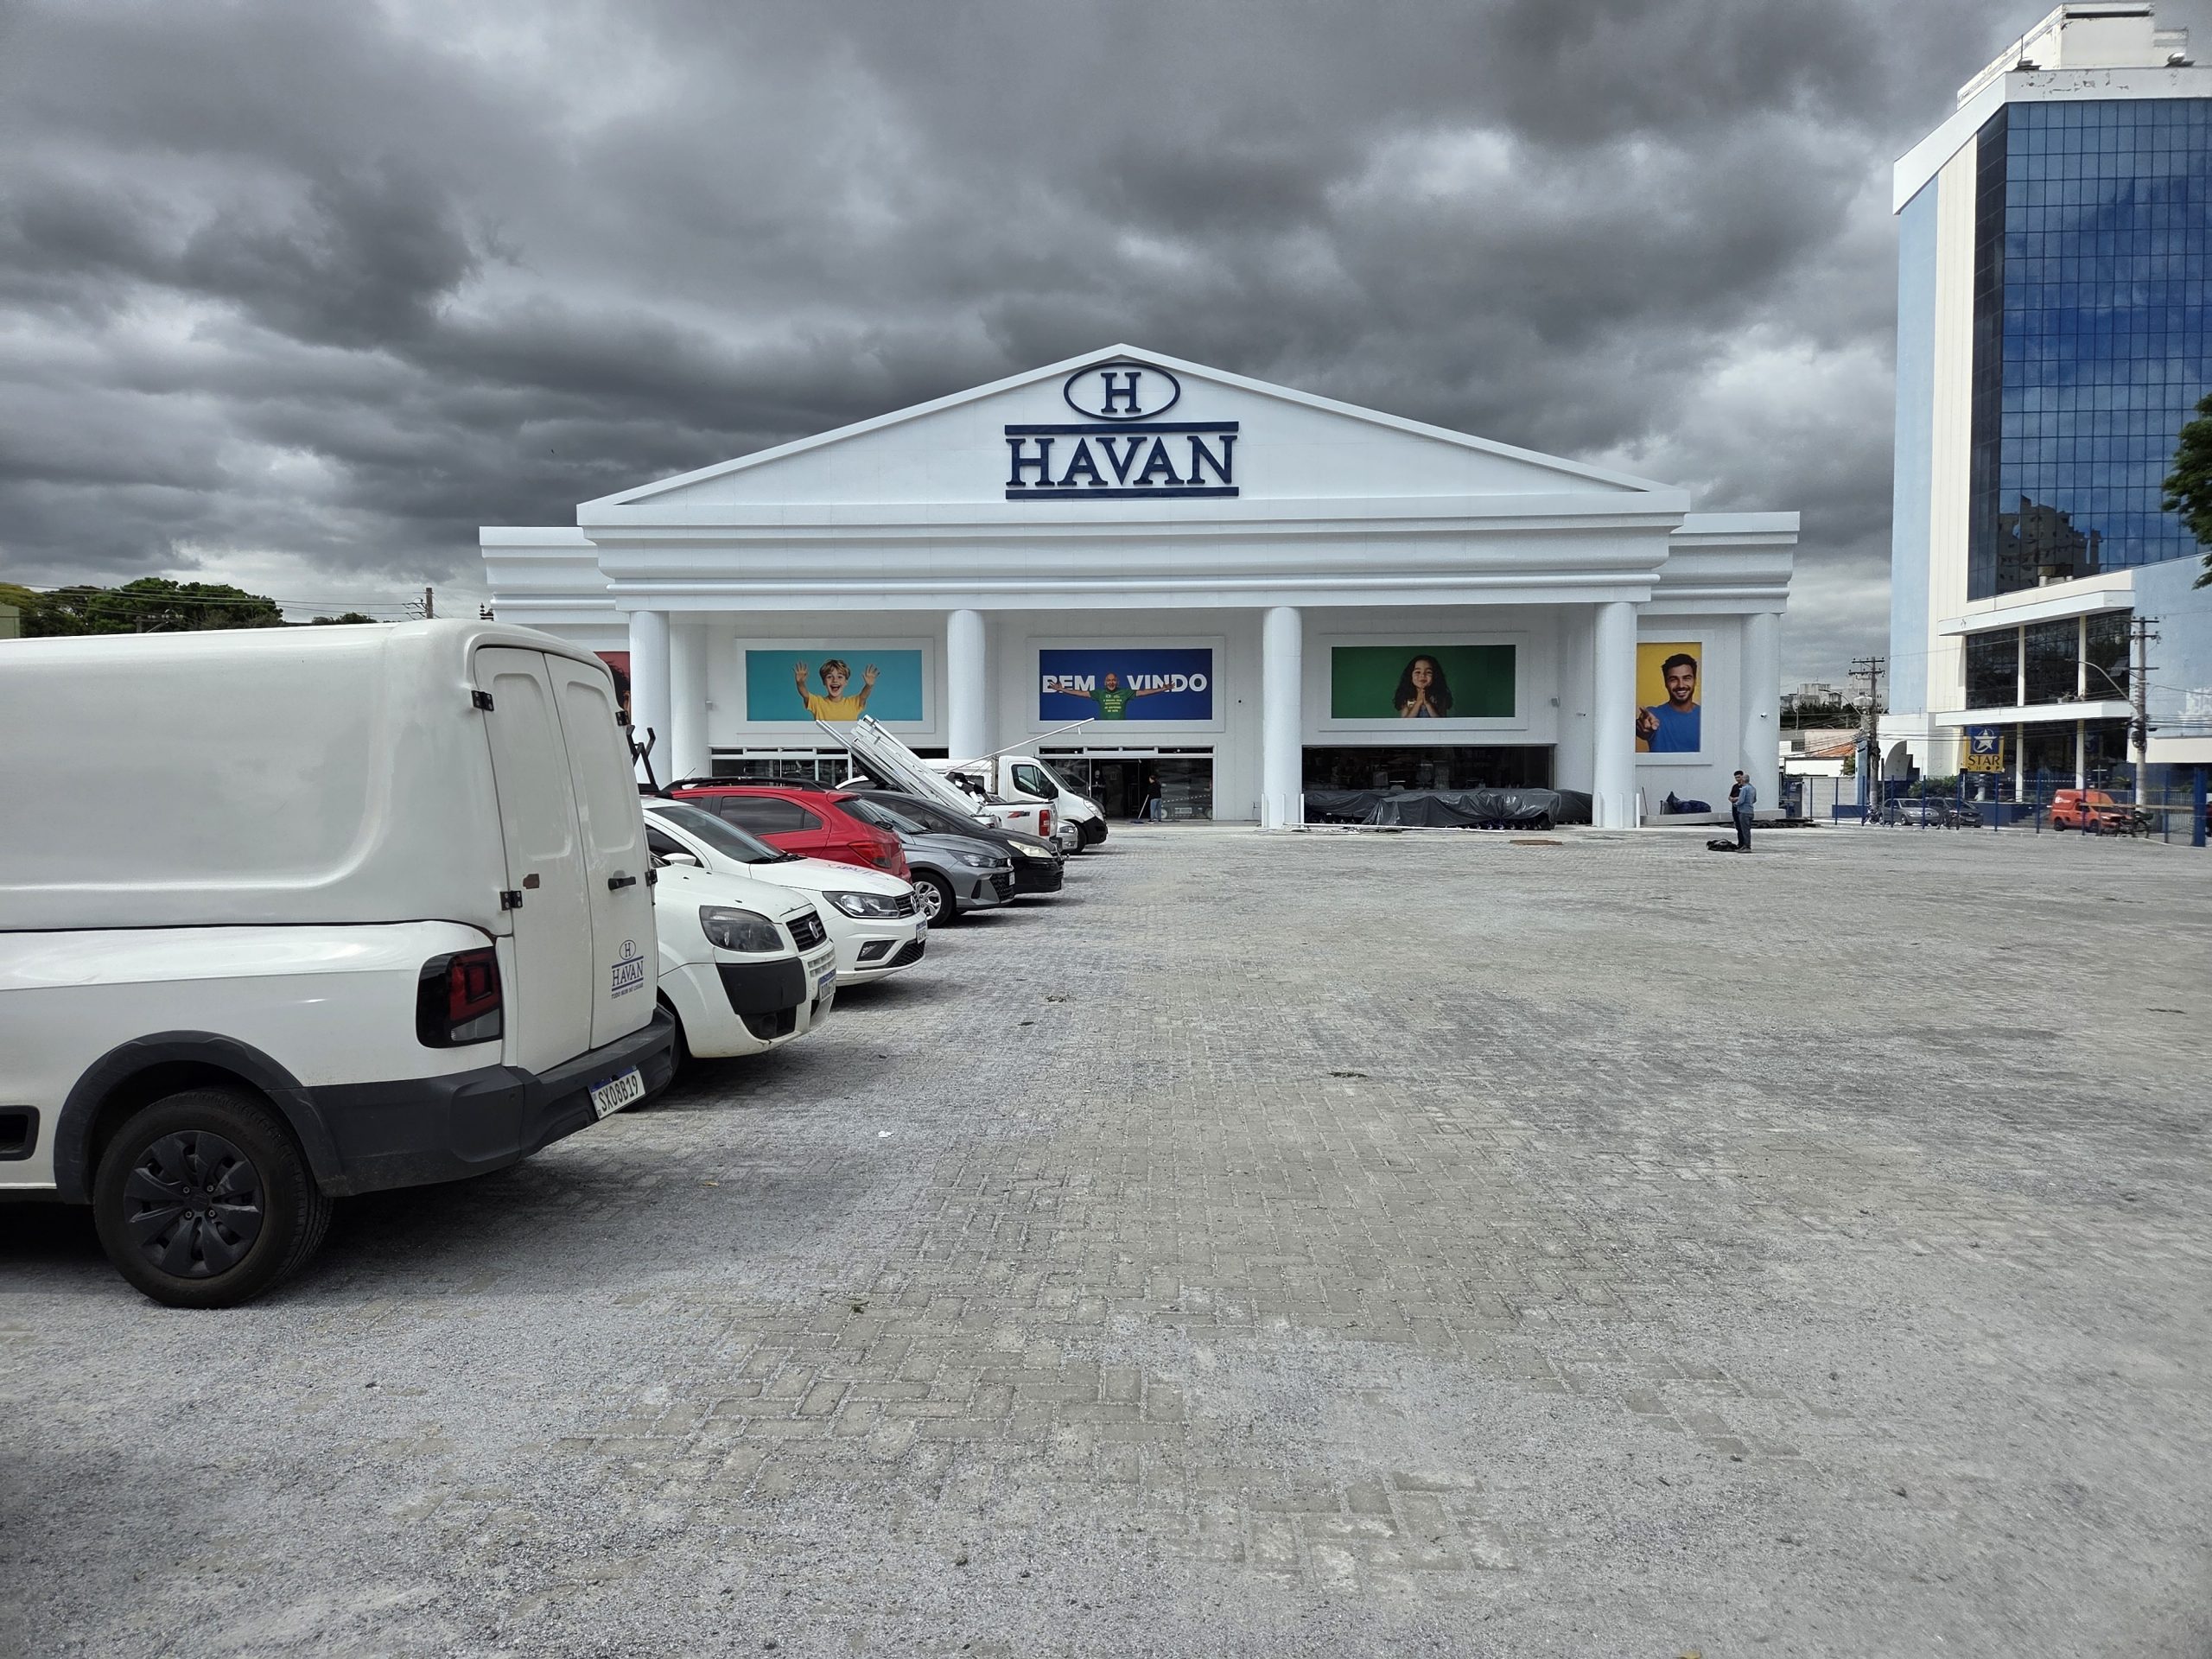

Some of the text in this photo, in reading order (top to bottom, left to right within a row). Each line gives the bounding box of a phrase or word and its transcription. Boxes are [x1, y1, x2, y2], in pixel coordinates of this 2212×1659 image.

[1100, 372, 1142, 413] H
[1005, 435, 1238, 486] HAVAN
[1042, 673, 1208, 694] BEM VINDO
[1967, 754, 2000, 766] STAR
[624, 942, 632, 958] H
[612, 960, 644, 987] HAVAN
